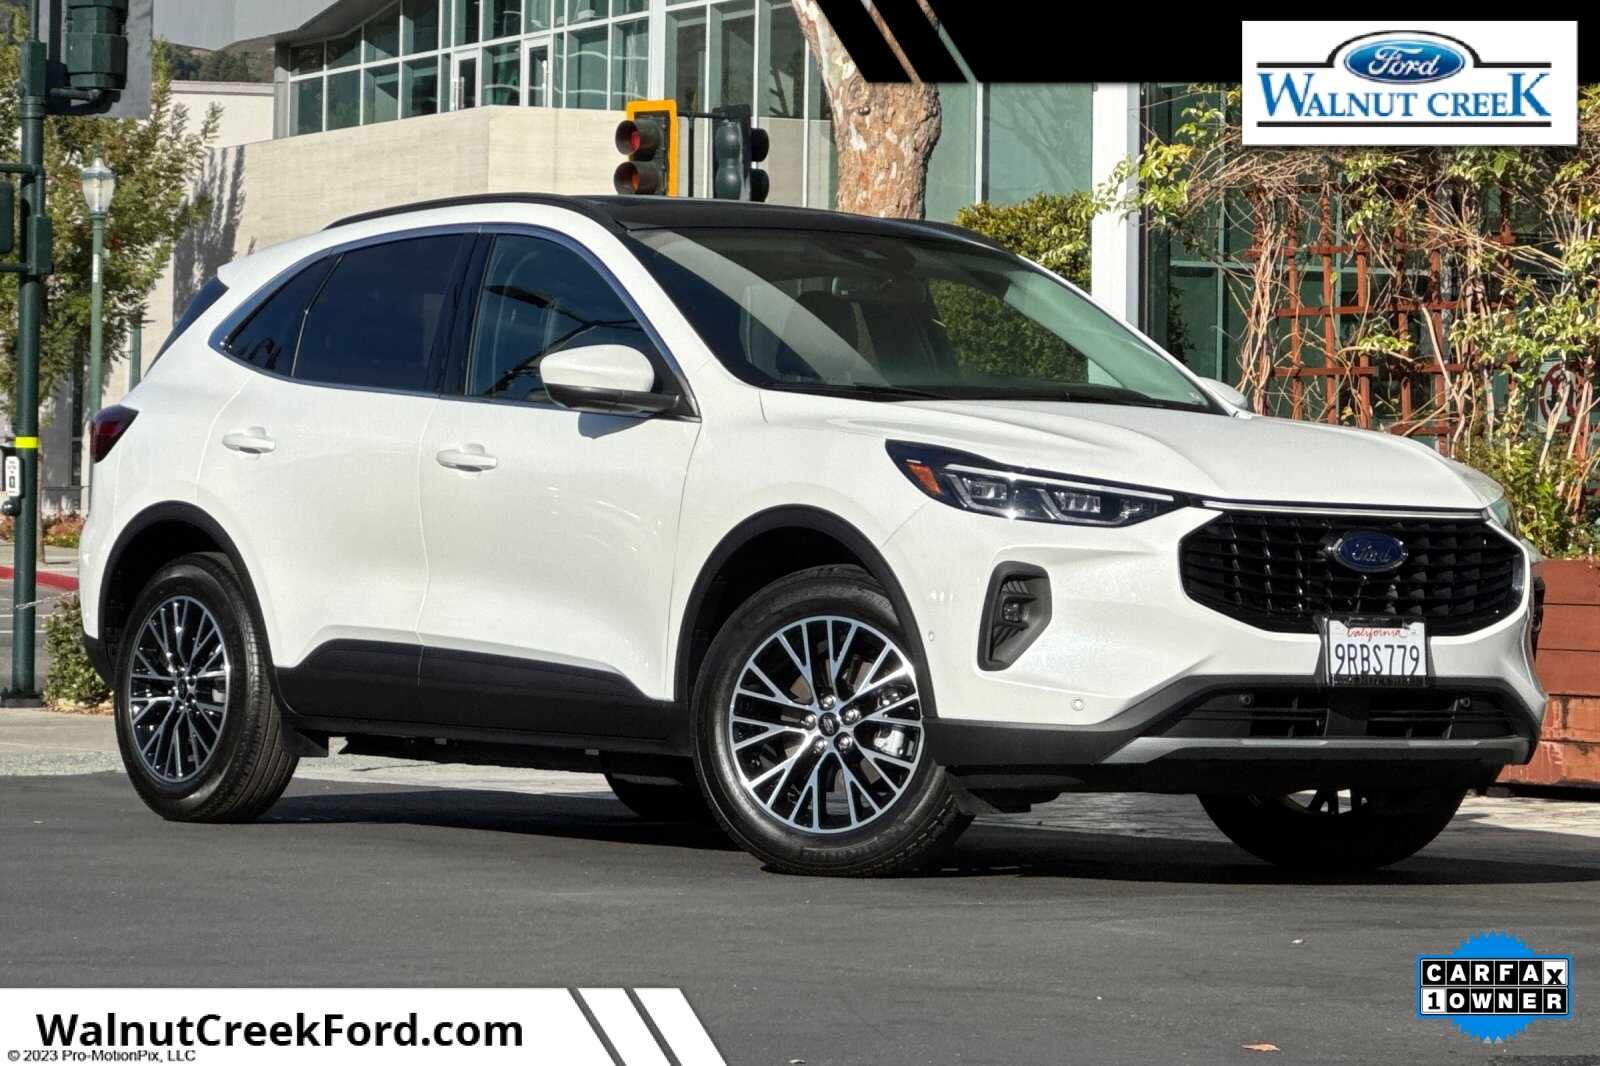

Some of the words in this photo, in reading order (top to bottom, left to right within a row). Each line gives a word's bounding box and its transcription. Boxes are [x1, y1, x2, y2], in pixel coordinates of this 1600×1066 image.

[1352, 543, 1392, 562] Ford
[1346, 626, 1402, 641] California
[1334, 643, 1420, 676] 9RBS779
